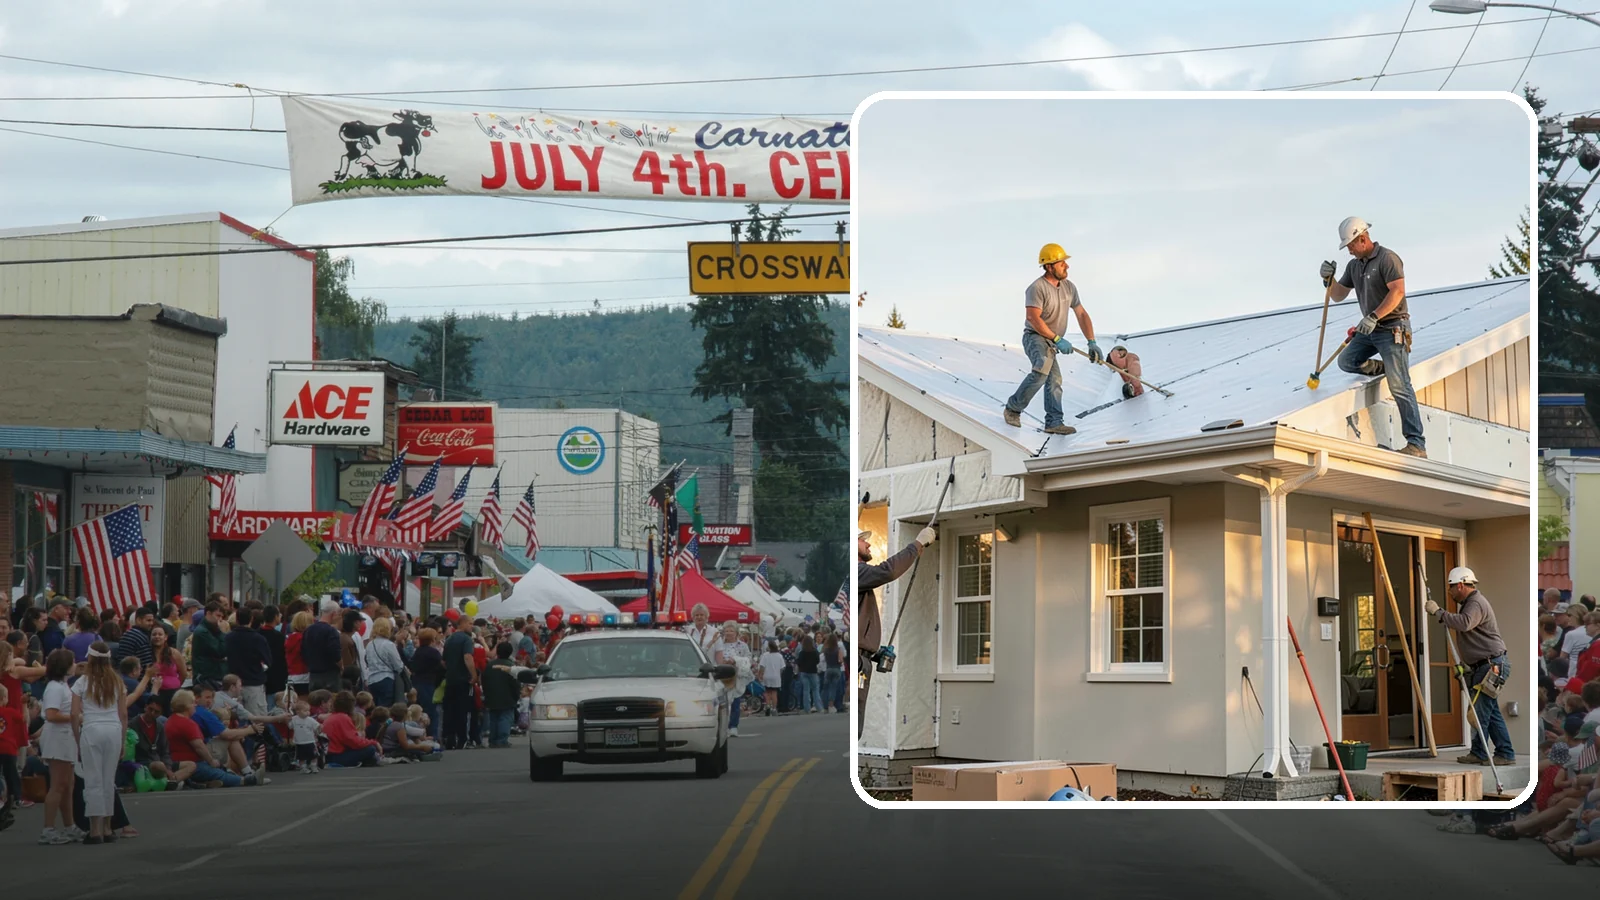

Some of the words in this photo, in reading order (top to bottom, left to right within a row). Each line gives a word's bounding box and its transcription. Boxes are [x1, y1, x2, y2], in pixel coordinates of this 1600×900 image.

[695, 121, 850, 150] Carnat
[481, 141, 604, 192] JULY
[632, 150, 746, 198] 4th.
[696, 255, 850, 280] CROSSWA
[283, 380, 373, 420] ACE
[405, 409, 452, 422] CEDAR
[284, 421, 371, 436] Hardware
[416, 428, 477, 447] Coca-Cola
[353, 467, 385, 480] Simpl
[96, 485, 124, 494] Vincent
[126, 486, 136, 494] de
[137, 486, 155, 495] Paul
[81, 503, 153, 521] THRT
[688, 526, 741, 535] CRNATION
[699, 535, 730, 543] GLASS
